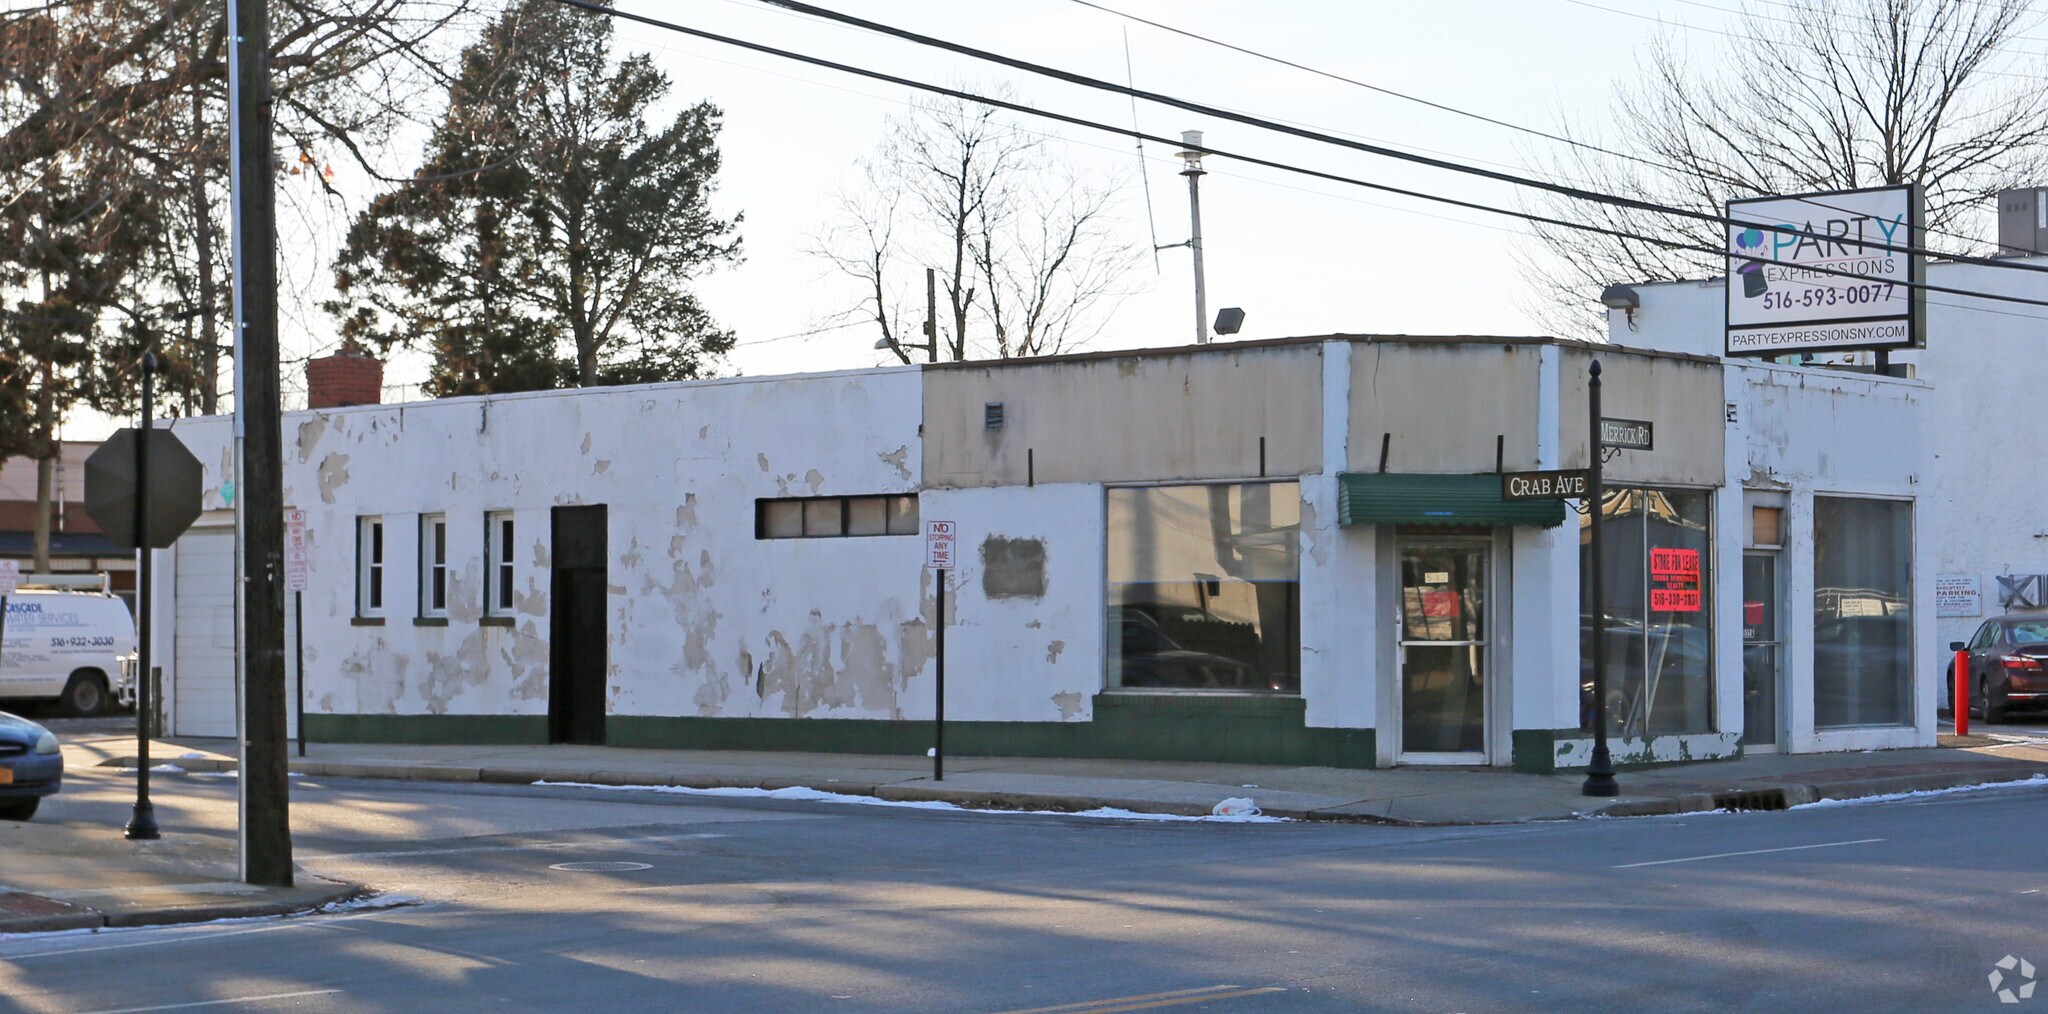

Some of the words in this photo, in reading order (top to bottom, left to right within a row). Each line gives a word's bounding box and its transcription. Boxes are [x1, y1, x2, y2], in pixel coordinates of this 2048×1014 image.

[1773, 213, 1904, 262] PARTY
[1767, 259, 1896, 282] EXPRESSIONS
[1763, 283, 1895, 310] 516-593-0077
[1732, 326, 1905, 346] PARTYEXPRESSIONSNY.COM
[1601, 423, 1636, 445] MERRICK
[1638, 427, 1650, 445] RD
[1510, 477, 1551, 496] CRAB
[1554, 475, 1585, 494] AVE
[933, 524, 949, 533] NO
[933, 551, 949, 559] TIME
[934, 542, 948, 550] ANY
[1654, 553, 1670, 570] STORE
[1671, 554, 1681, 571] FOR
[1682, 555, 1698, 571] LEASE
[6, 603, 42, 613] CASCADE
[38, 612, 80, 624] SERVICES
